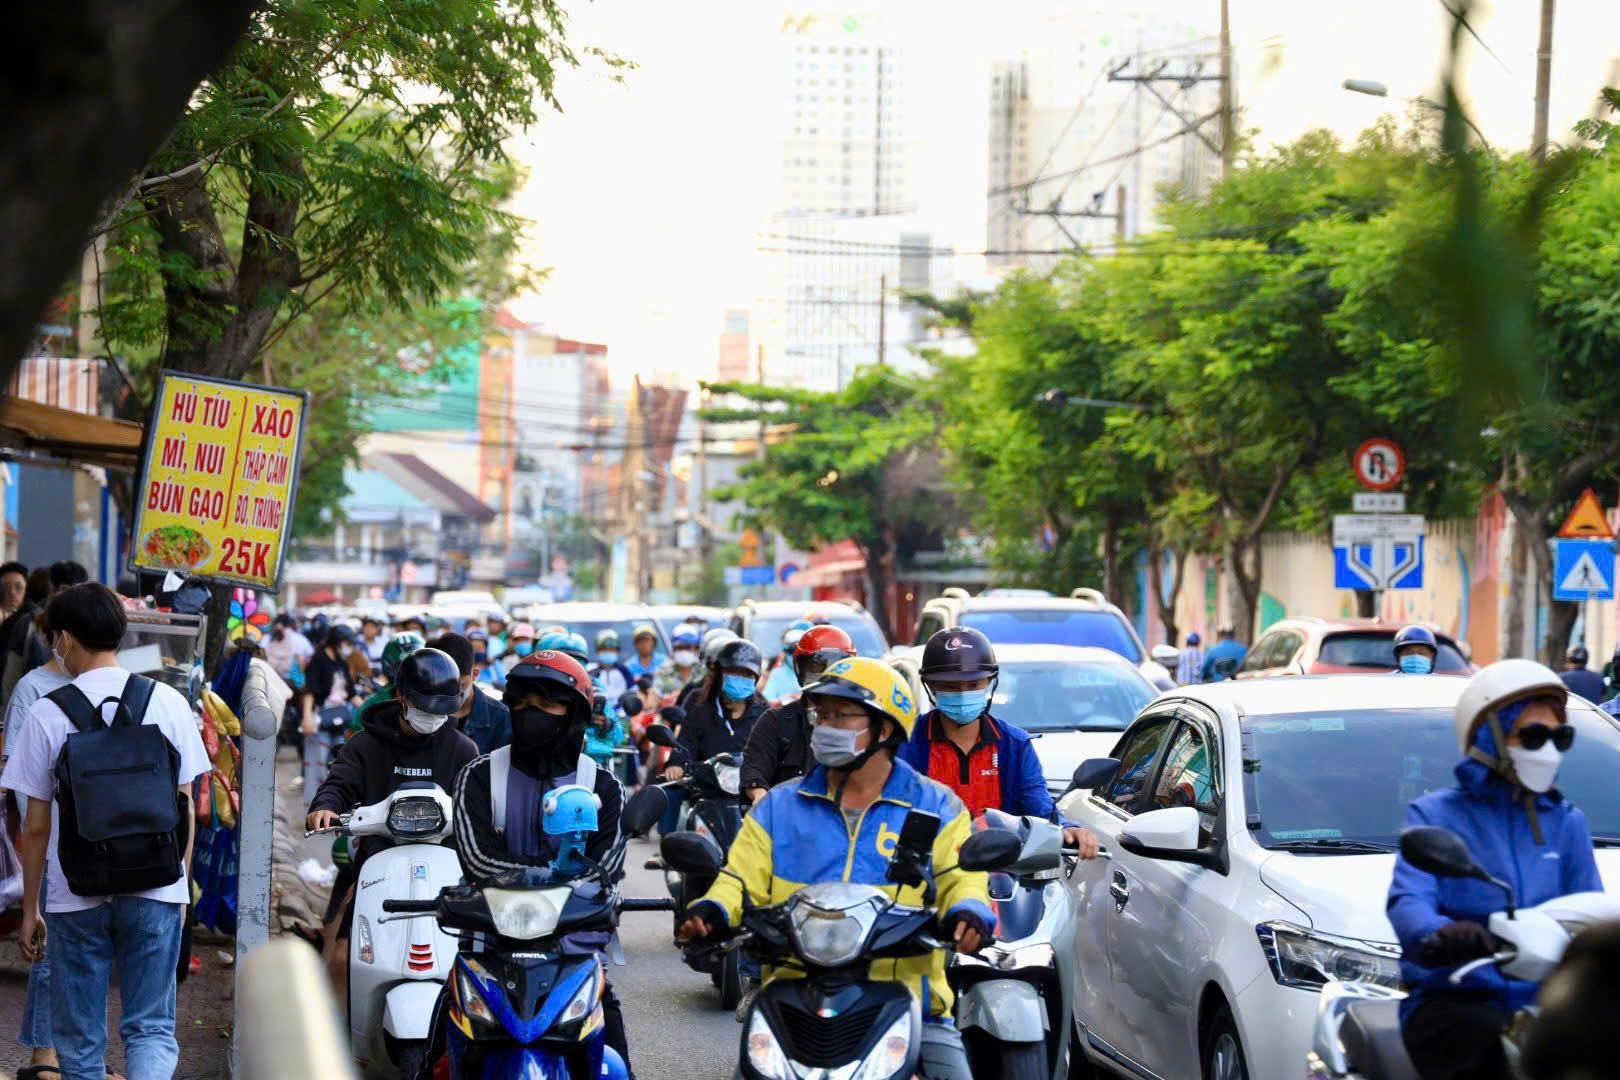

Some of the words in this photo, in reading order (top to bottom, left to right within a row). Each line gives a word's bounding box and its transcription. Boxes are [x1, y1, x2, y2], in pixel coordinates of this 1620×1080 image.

[251, 399, 294, 439] XÀO
[161, 432, 187, 475] MÌ,
[194, 442, 226, 475] NUI
[147, 475, 185, 514] BÚN
[189, 487, 224, 525] GẠO
[218, 537, 271, 578] 25K
[511, 952, 548, 960] HONDA
